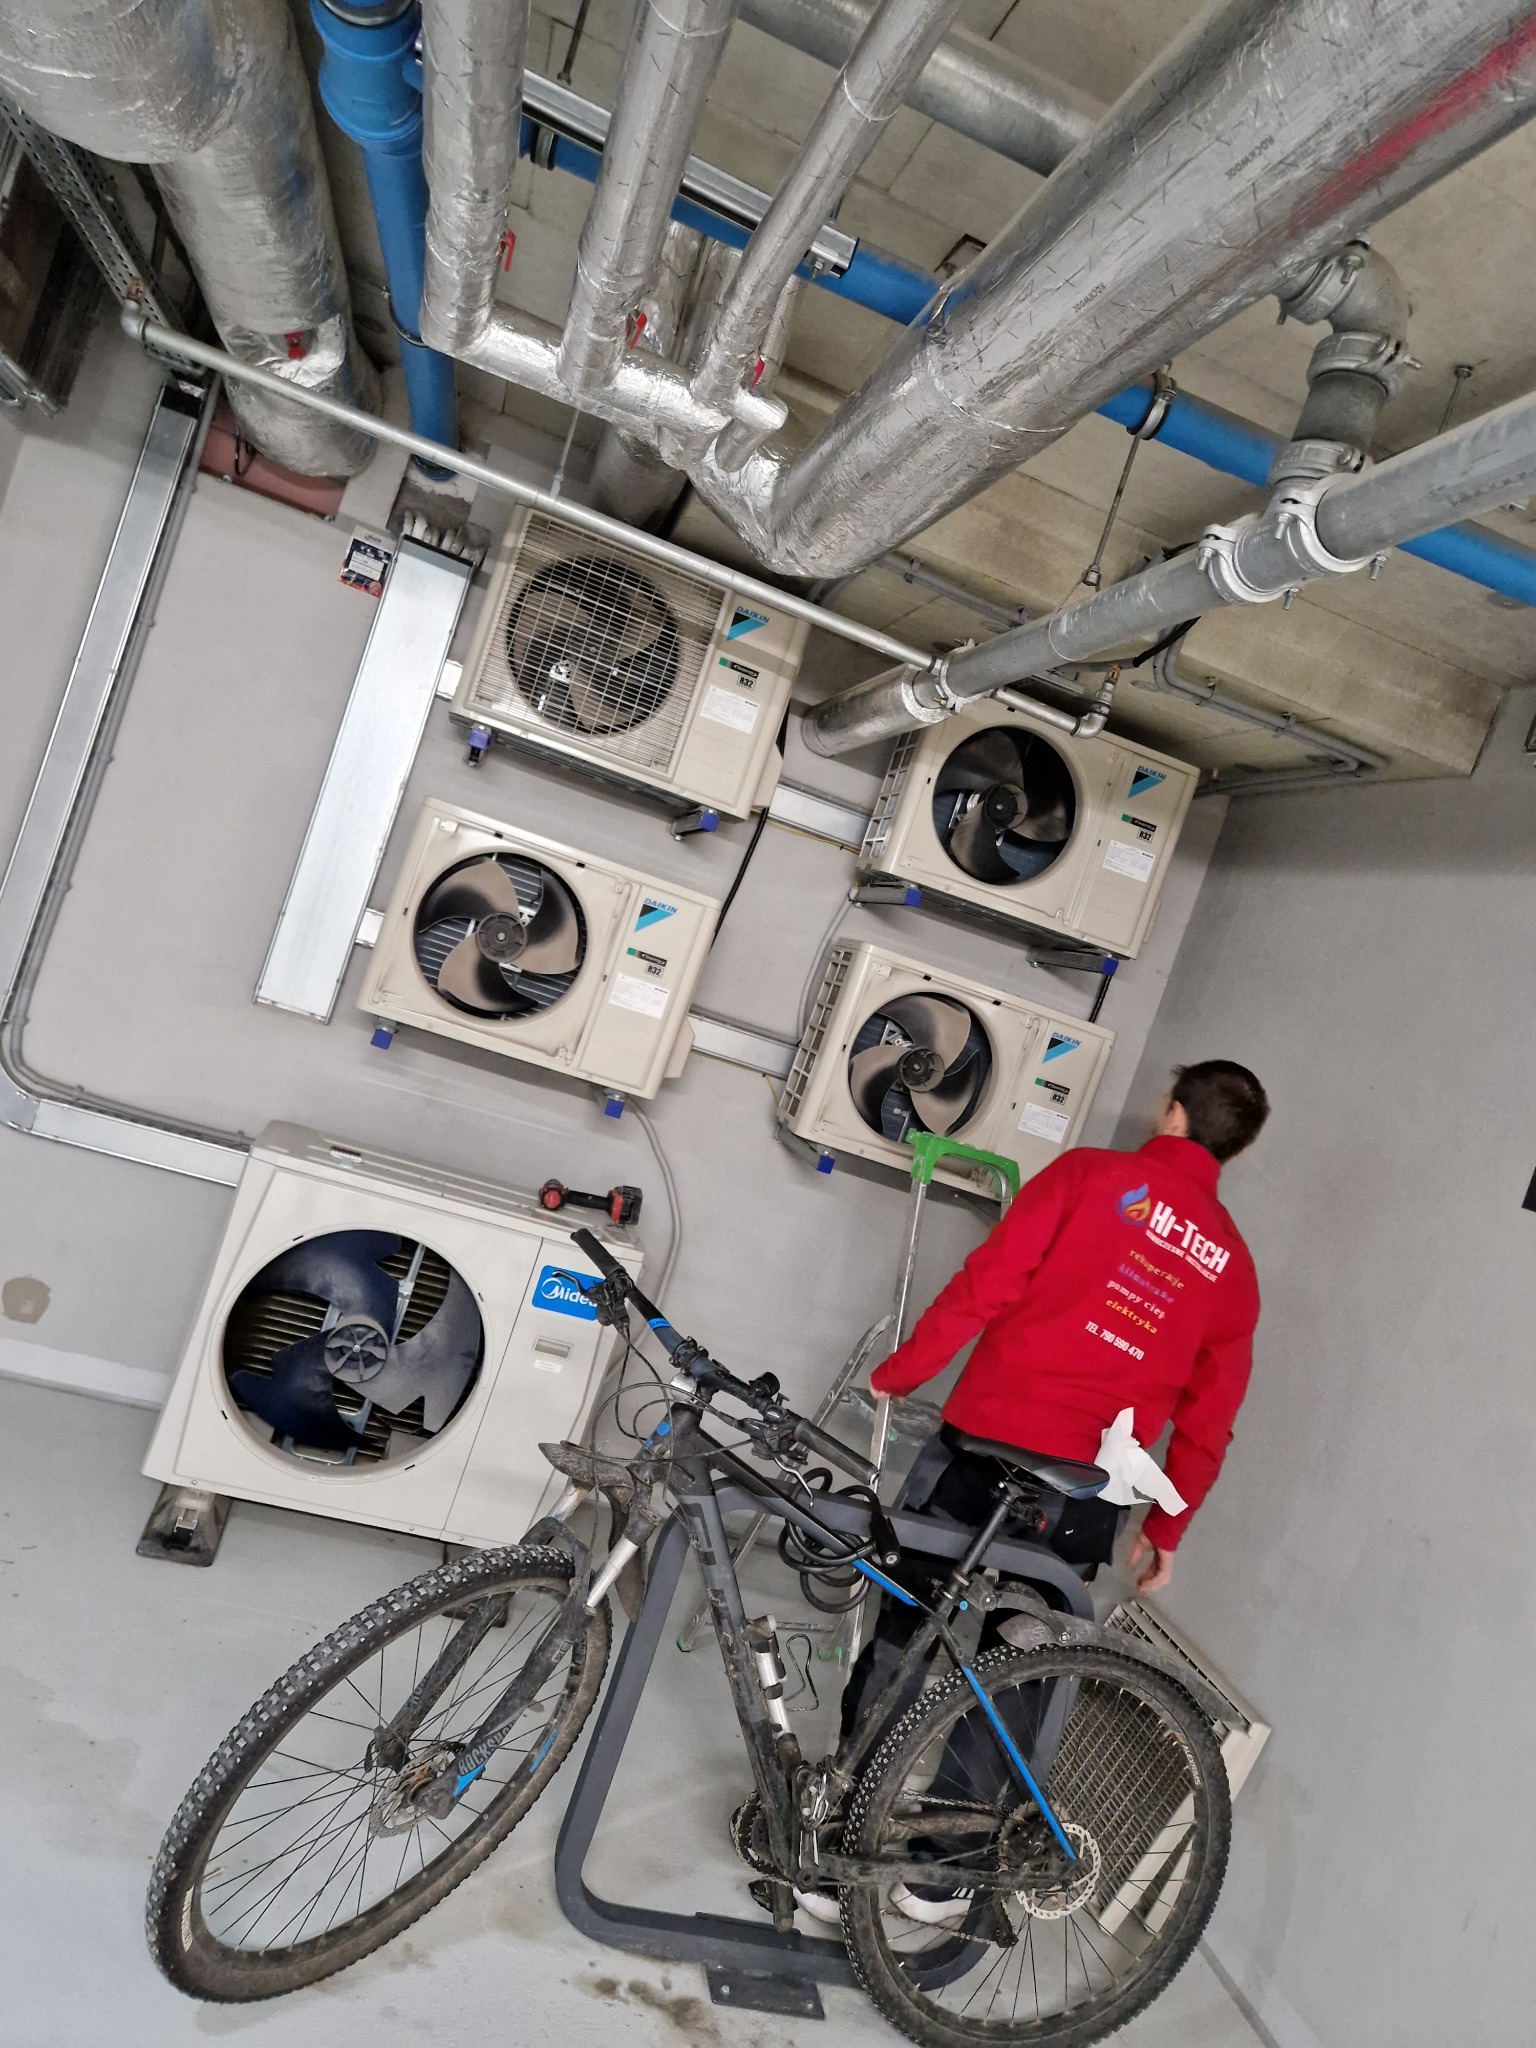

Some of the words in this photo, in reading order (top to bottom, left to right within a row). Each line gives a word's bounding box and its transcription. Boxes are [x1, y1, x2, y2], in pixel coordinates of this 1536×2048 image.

[1225, 135, 1275, 180] ROCKWOOL
[736, 605, 770, 624] DAIKIN
[739, 676, 754, 689] R32
[1137, 765, 1167, 780] DAIKIN
[1138, 830, 1152, 841] R32
[643, 897, 678, 914] DAIKIN
[646, 965, 662, 977] R32
[1052, 1031, 1082, 1046] DAIKIN
[1052, 1093, 1065, 1104] R32
[1149, 1200, 1231, 1274] HI-TECH
[1106, 1299, 1158, 1335] elektryka
[1127, 1345, 1145, 1361] 470
[458, 1720, 516, 1776] ROCKSHO
